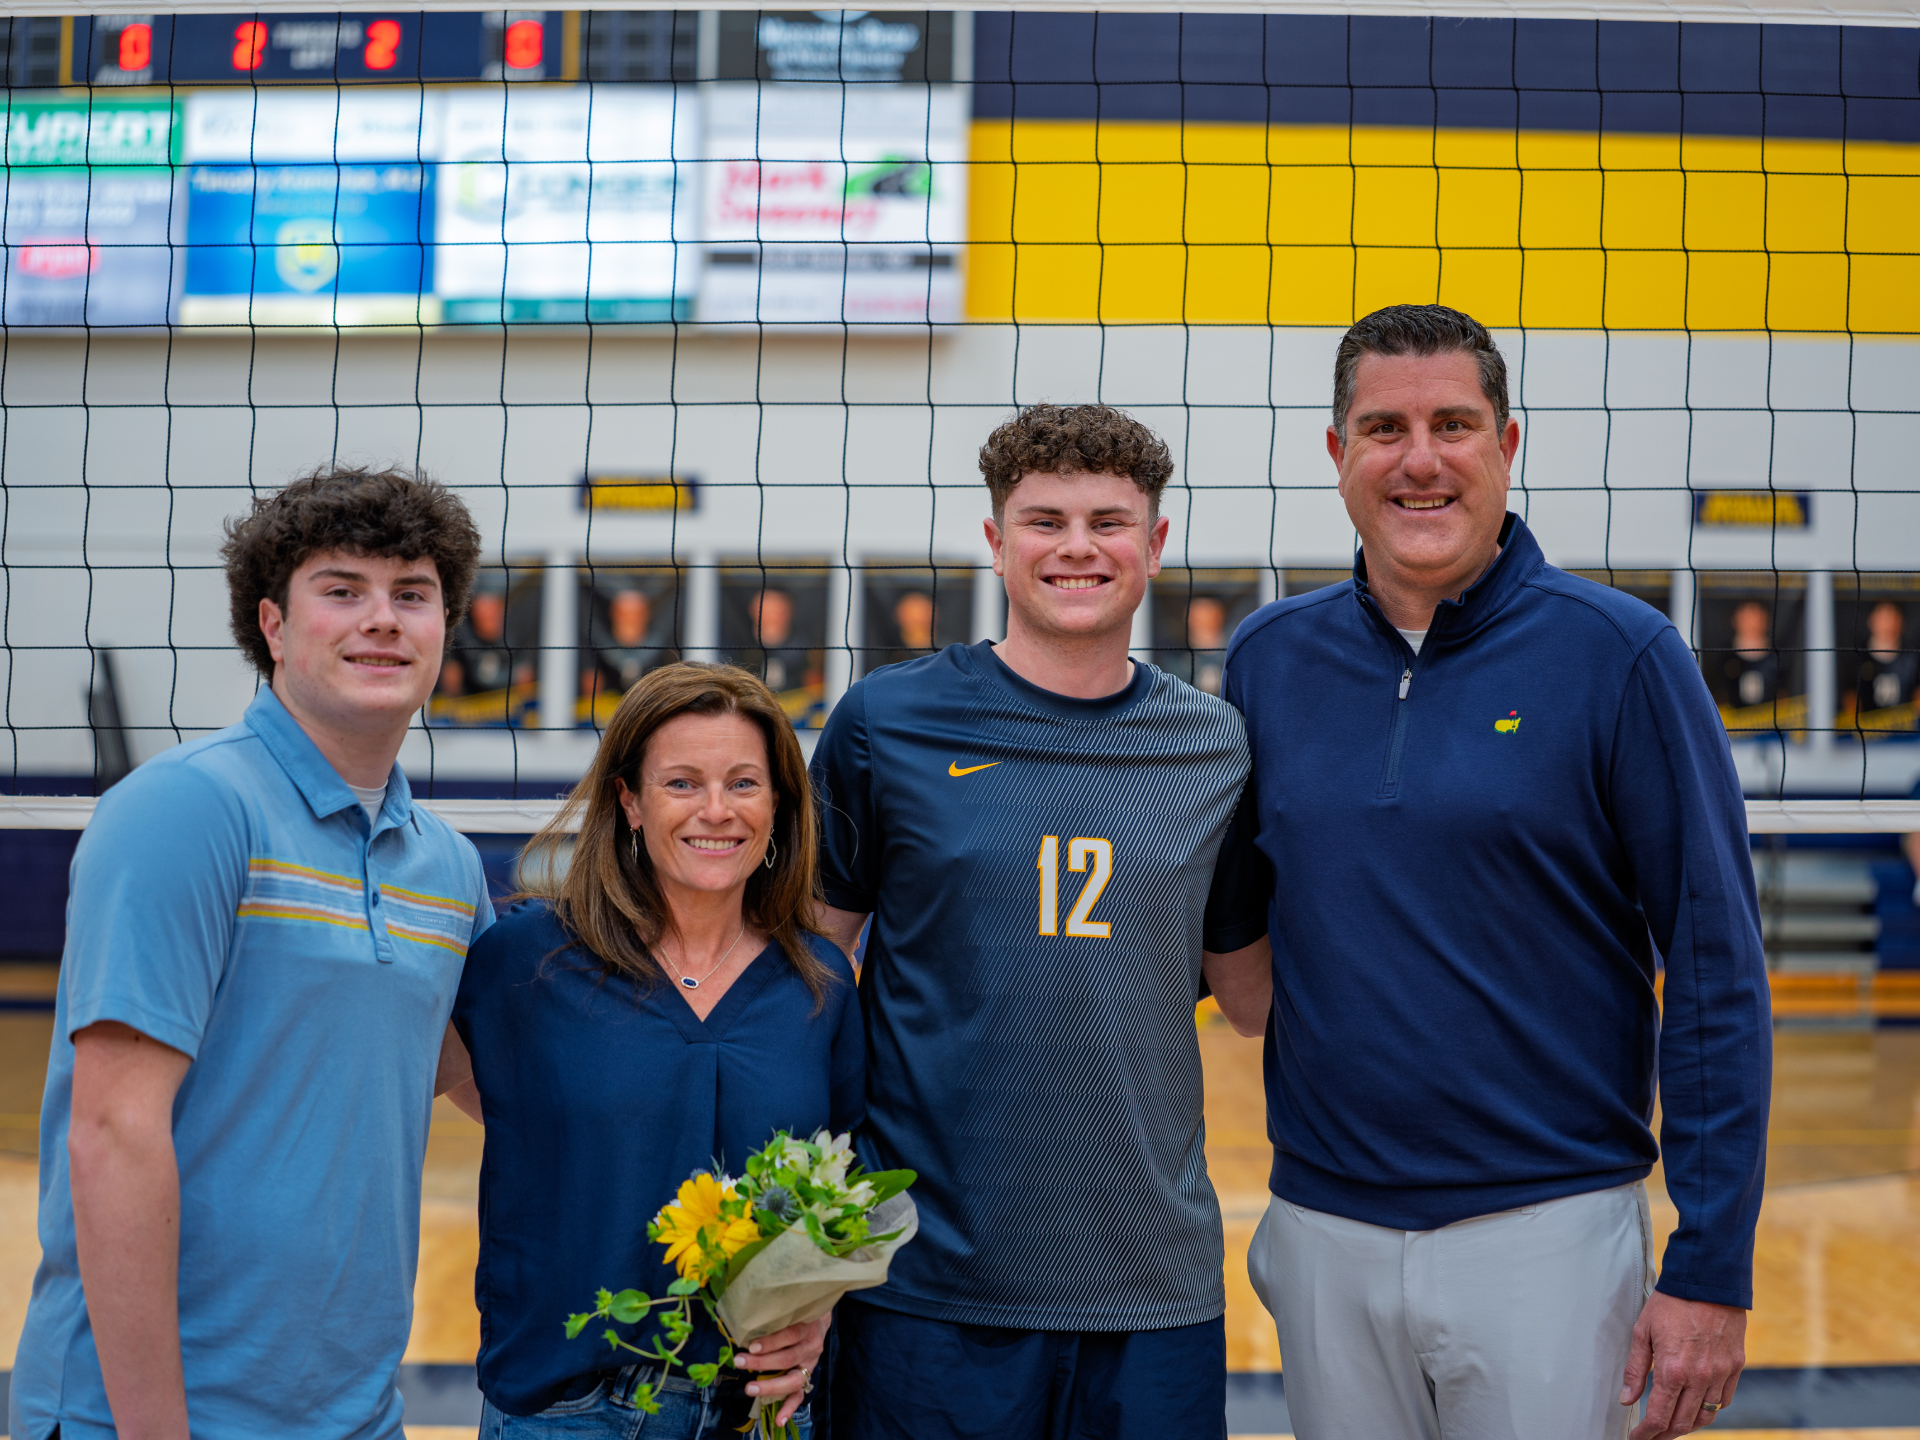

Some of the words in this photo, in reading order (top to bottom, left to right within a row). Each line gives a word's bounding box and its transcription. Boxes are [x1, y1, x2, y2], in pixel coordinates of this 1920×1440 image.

[232, 21, 267, 70] 2
[364, 20, 400, 70] 2
[1037, 835, 1113, 938] 12
